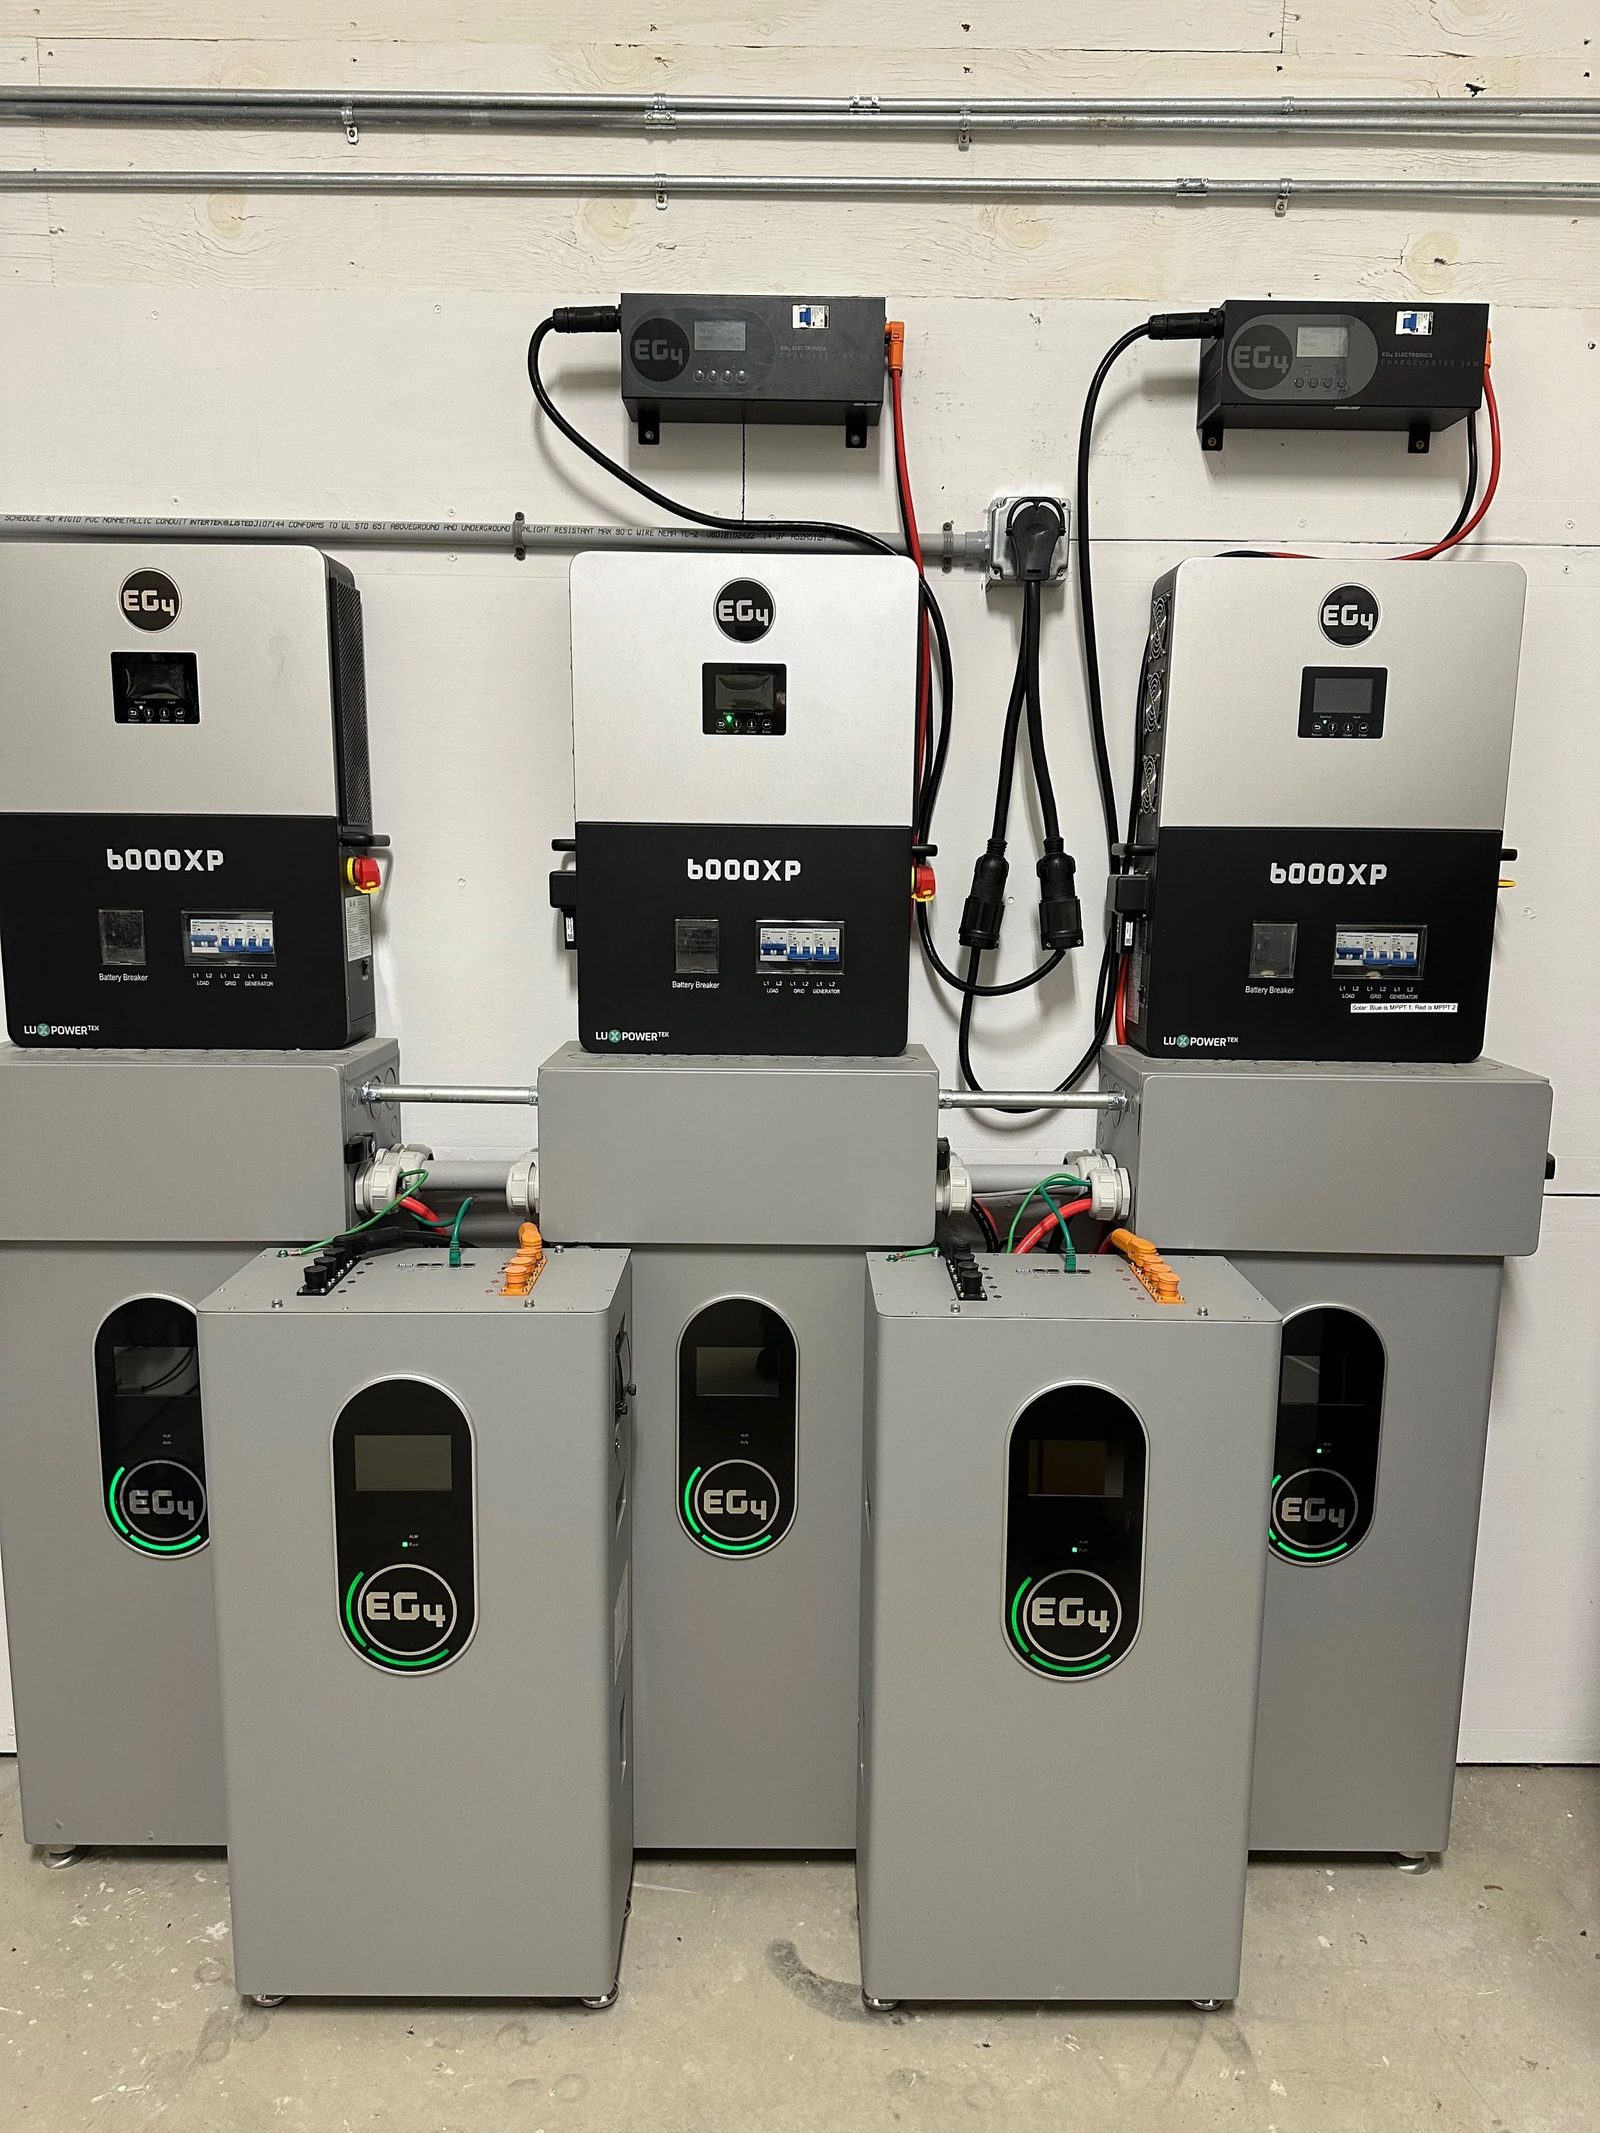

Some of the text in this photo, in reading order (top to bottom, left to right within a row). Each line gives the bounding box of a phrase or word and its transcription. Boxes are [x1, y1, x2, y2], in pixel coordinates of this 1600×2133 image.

[634, 338, 683, 366] EG4
[1233, 345, 1289, 374] EG4
[1381, 359, 1456, 367] CHARGEVERTER
[5, 515, 41, 523] SCHEDULE
[45, 515, 55, 523] 40
[85, 516, 98, 524] PVC
[103, 516, 152, 525] NONMETALLIC
[288, 520, 325, 529] CONFORMS
[341, 522, 351, 530] UL
[390, 523, 440, 531] ABOVEGROUND
[461, 524, 511, 533] UNDERGROUND
[554, 526, 594, 535] RESISTANT
[598, 528, 612, 536] MAX
[636, 529, 654, 537] WIRE
[658, 529, 677, 537] NEMA
[123, 589, 176, 617] EG4
[718, 599, 769, 627] EG4
[1322, 604, 1374, 631] EG4
[106, 848, 224, 872] 6000XP
[687, 858, 801, 882] 6000XP
[1269, 862, 1388, 886] 6000XP
[99, 973, 149, 983] Battery Breaker
[672, 980, 720, 990] Battery Breaker
[1245, 985, 1295, 995] Battery Breaker
[128, 1489, 195, 1521] EG4
[703, 1489, 767, 1521] EG4
[1281, 1497, 1345, 1528] EG4
[366, 1591, 446, 1628] EG4
[1031, 1597, 1110, 1633] EG4
